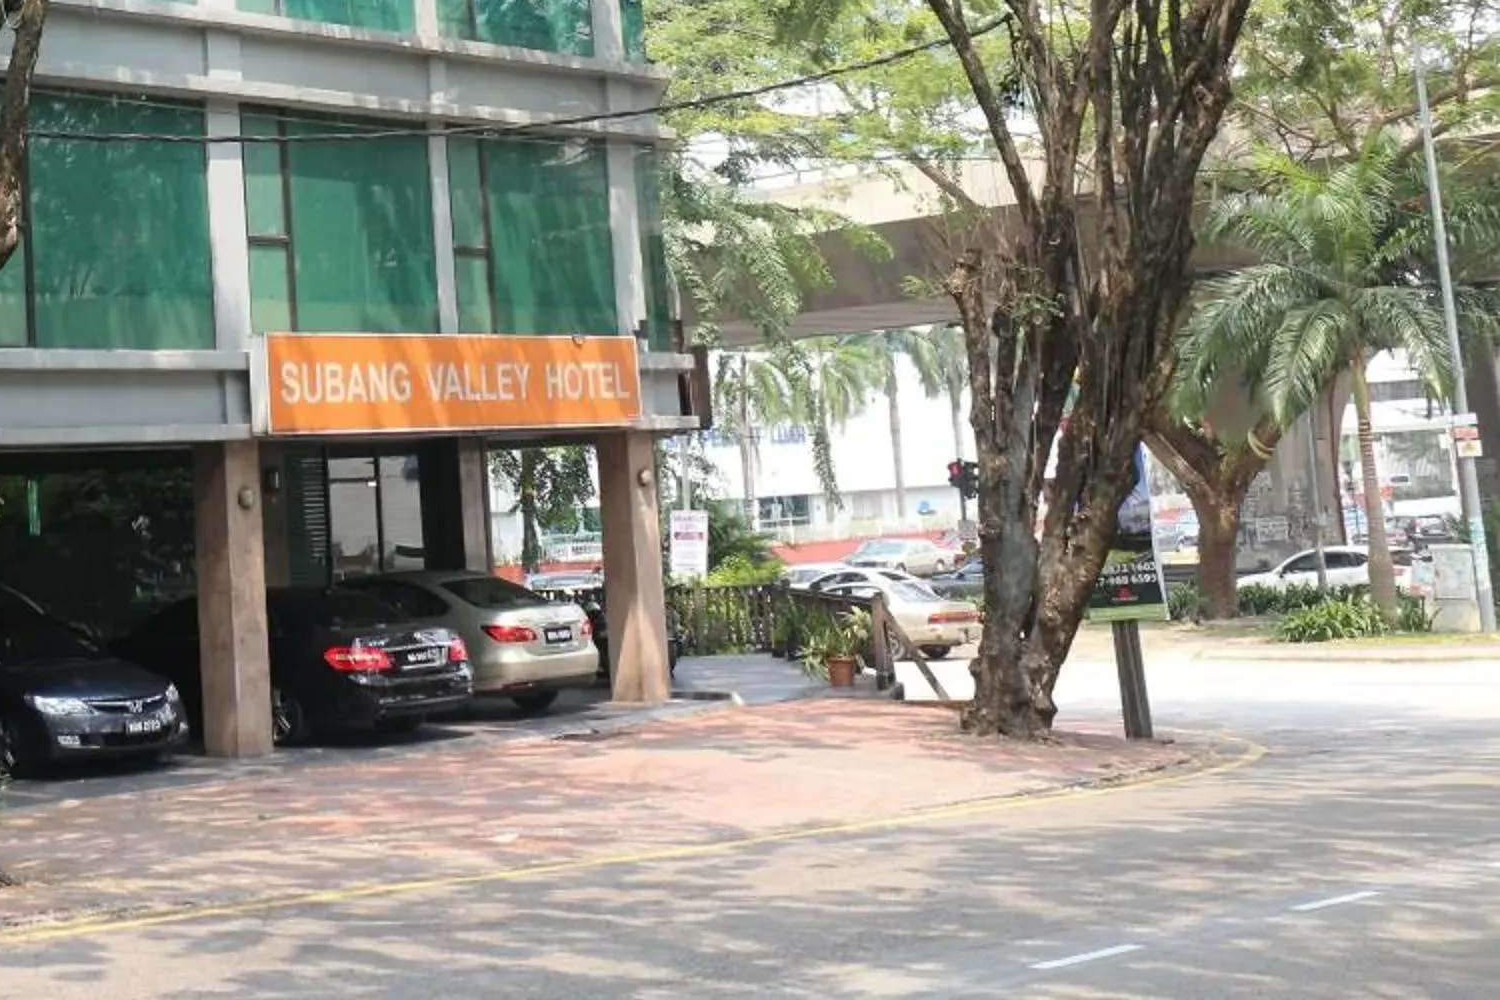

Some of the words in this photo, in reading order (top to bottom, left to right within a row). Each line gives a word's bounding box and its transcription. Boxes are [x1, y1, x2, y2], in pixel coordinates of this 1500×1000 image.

[281, 361, 412, 405] SUBANG
[428, 363, 531, 402] VALLEY
[546, 362, 631, 400] HOTEL
